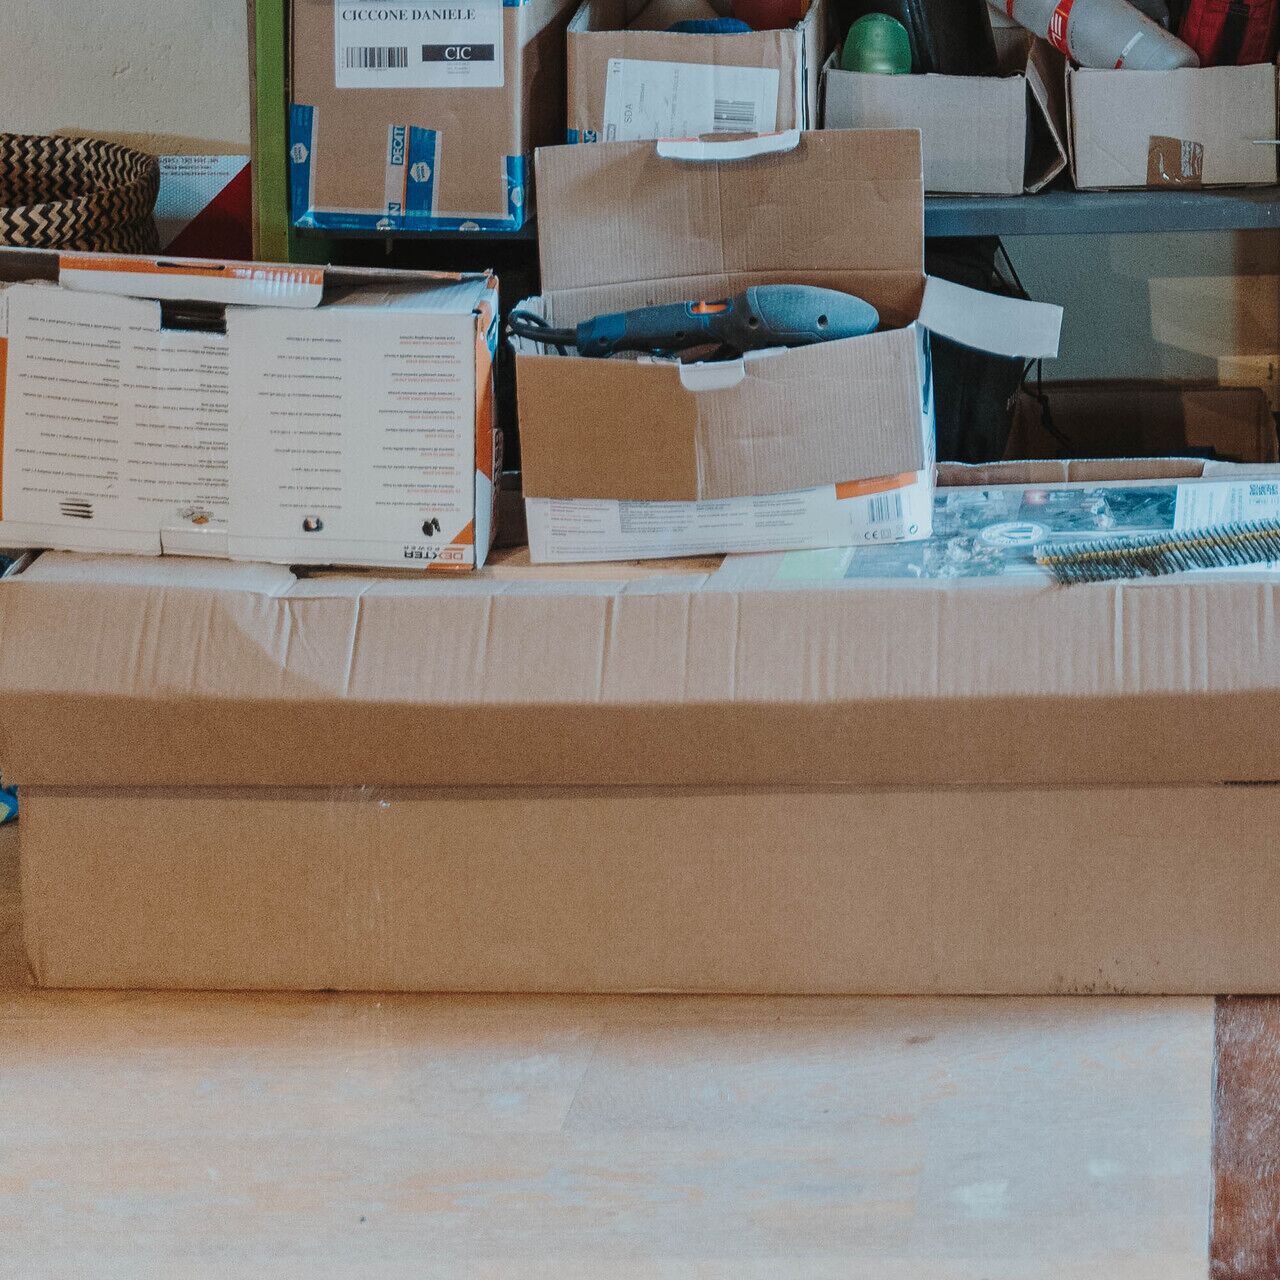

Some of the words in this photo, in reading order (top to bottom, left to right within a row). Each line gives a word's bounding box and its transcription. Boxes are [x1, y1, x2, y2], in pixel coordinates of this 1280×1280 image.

[342, 8, 408, 21] CICCONE
[412, 8, 476, 20] DANIELE
[444, 46, 472, 59] CIC
[624, 103, 633, 124] SDA
[393, 127, 404, 164] DECAT
[404, 551, 464, 560] DEXTER
